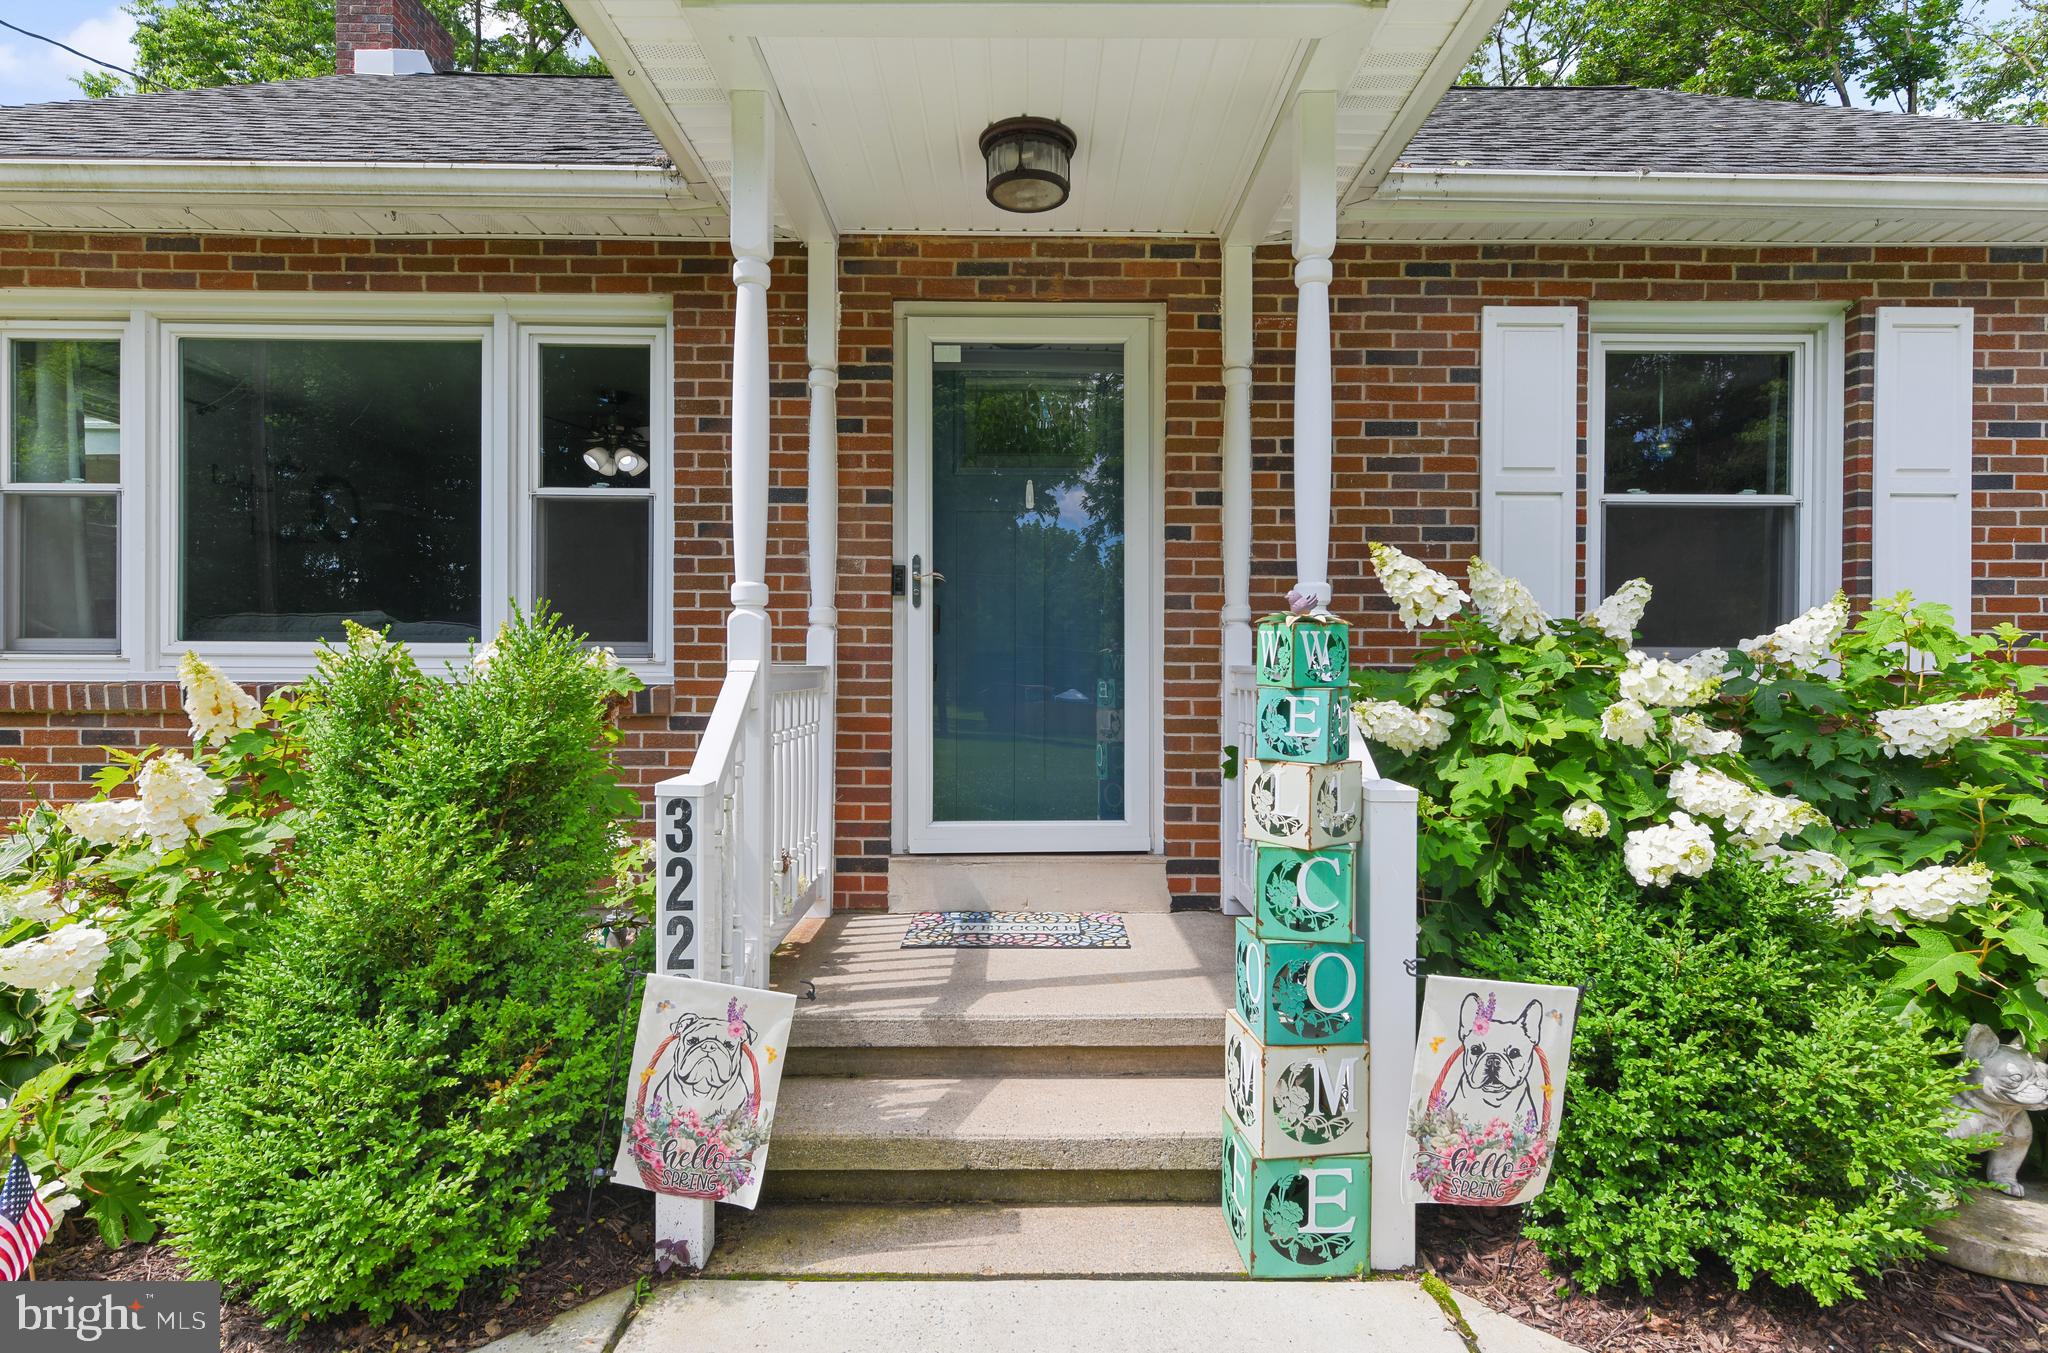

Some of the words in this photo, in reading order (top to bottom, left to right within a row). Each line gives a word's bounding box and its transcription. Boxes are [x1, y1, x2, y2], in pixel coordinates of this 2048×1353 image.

[665, 797, 695, 979] 322
[958, 924, 1078, 932] WELCOME
[662, 1139, 725, 1170] hello
[1451, 1147, 1514, 1179] hello
[662, 1169, 718, 1191] SPRING
[1450, 1178, 1506, 1198] SPRING
